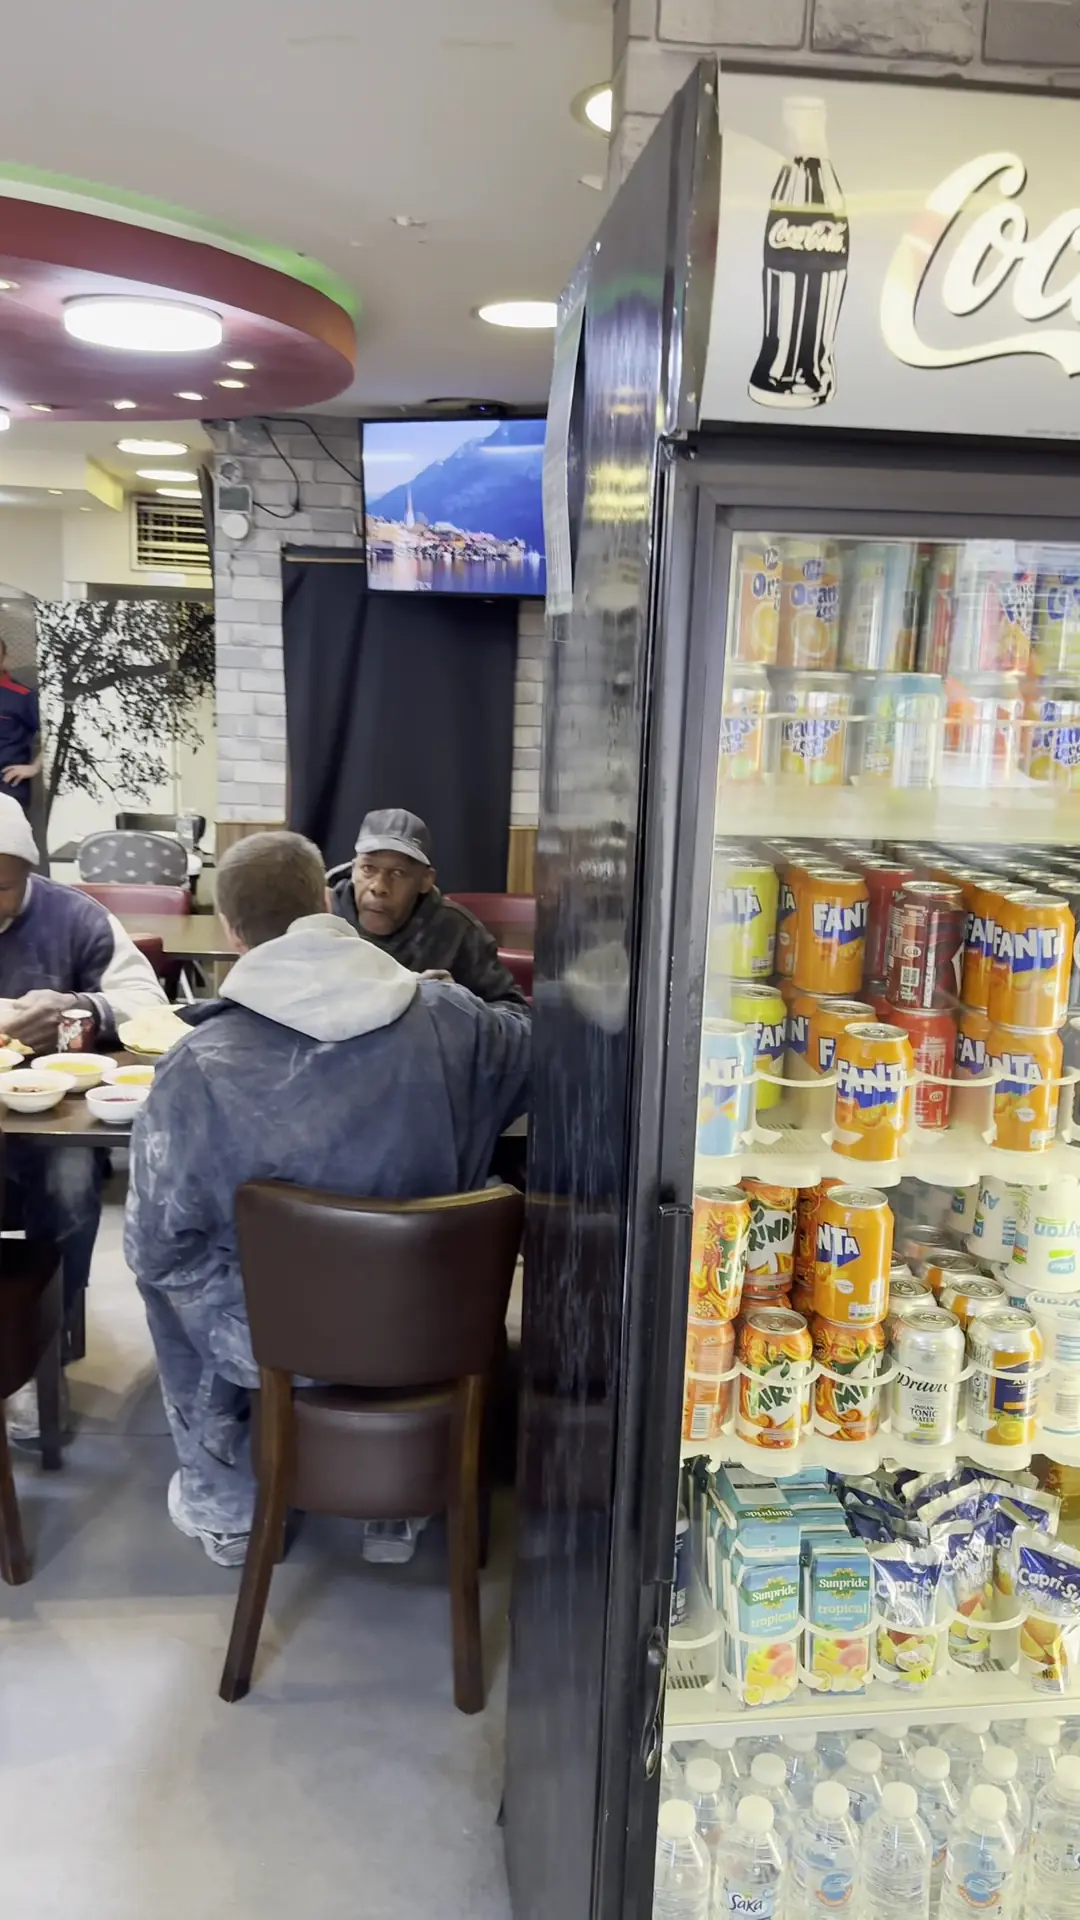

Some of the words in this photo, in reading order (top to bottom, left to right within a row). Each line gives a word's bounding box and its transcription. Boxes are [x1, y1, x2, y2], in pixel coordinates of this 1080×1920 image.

[880, 151, 1080, 378] Coc
[910, 1407, 938, 1418] TONIC
[912, 1415, 935, 1423] WATER
[819, 1578, 868, 1590] Sunpride
[752, 1585, 797, 1602] Sunpride
[818, 1603, 867, 1617] tropical
[751, 1610, 797, 1628] tropical
[729, 1895, 763, 1912] Saka
